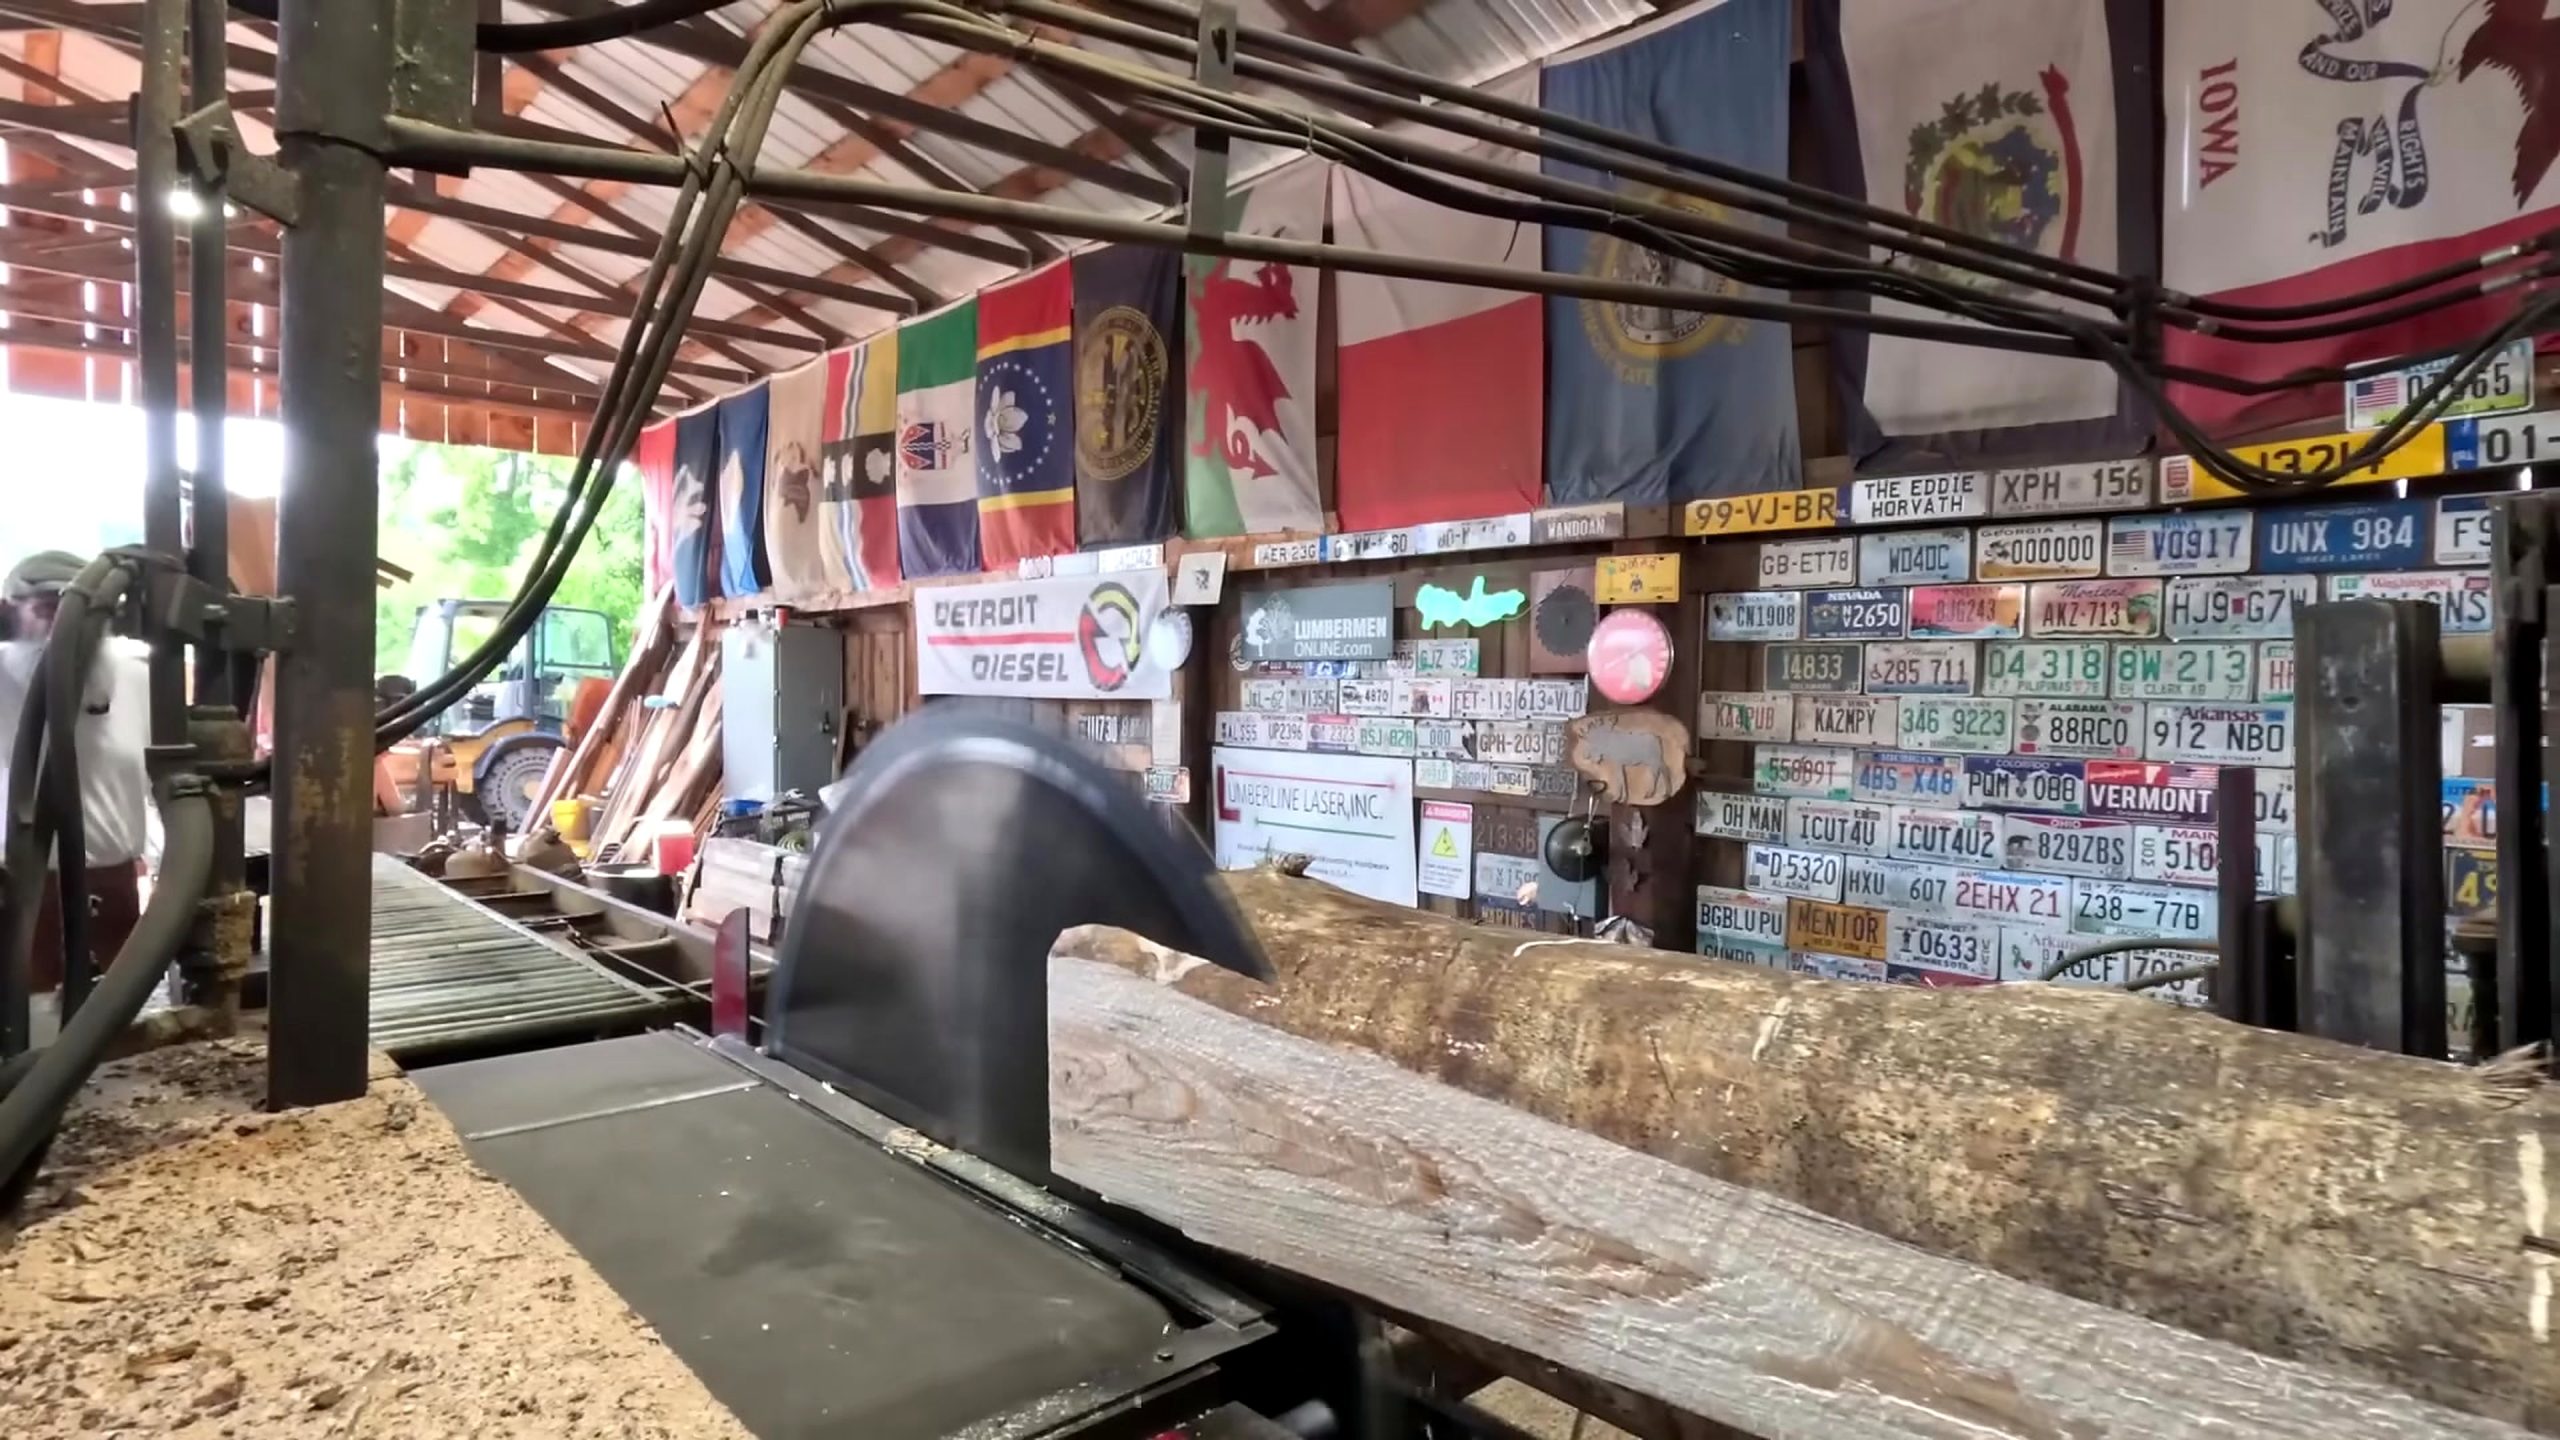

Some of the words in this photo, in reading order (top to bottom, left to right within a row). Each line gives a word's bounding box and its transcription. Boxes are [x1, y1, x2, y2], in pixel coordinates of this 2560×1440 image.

[2303, 51, 2341, 76] AND
[2346, 63, 2379, 79] OUR
[2200, 57, 2239, 189] IOWA
[2400, 119, 2425, 189] RIGHTS
[2329, 122, 2358, 232] MAINTAIN
[1864, 479, 1901, 500] THE
[1910, 475, 1974, 497] EDDIE
[2001, 471, 2061, 504] XPH
[2092, 466, 2144, 498] 156
[1694, 491, 1836, 530] 99-VJ-BR
[1871, 495, 1965, 518] HORVATH
[1546, 518, 1606, 538] WANDOAN
[1980, 526, 2055, 538] GEORGIA
[2270, 519, 2329, 555] UNX
[2351, 515, 2414, 551] 984
[1760, 549, 1849, 577] GB-ET78
[1826, 590, 1882, 601] NEVADA
[934, 594, 1039, 628] DETROIT
[1852, 602, 1901, 629] 2650
[1294, 616, 1387, 641] LUMBERMEN
[1293, 641, 1374, 658] ONLINE.com
[971, 653, 1069, 682] DIESEL
[1781, 653, 1843, 681] 14833
[1883, 658, 1920, 685] 285
[1930, 658, 1966, 685] 711
[2040, 649, 2100, 680] 318
[2117, 649, 2162, 682] 8W
[2176, 649, 2246, 683] 213
[1517, 688, 1547, 711] 613
[2048, 703, 2108, 714] ALABAMA
[1902, 707, 1941, 735] 346
[1952, 707, 2006, 737] 9223
[2178, 705, 2261, 724] Arkansas
[1479, 734, 1542, 755] GPH-203
[2152, 719, 2207, 750] 912
[1995, 759, 2051, 770] COLORADO
[1968, 770, 2010, 798] PQM
[2089, 783, 2213, 815] VERMONT
[1722, 802, 1744, 828] OH
[1749, 808, 1783, 833] MAN
[1800, 813, 1876, 847] ICUT4U
[2049, 818, 2082, 830] OHIO
[1897, 822, 1995, 858] ICUT4U2
[2170, 829, 2218, 842] MAIN
[1771, 879, 1811, 892] ALASKA
[1849, 869, 1886, 896] HXU
[1909, 877, 1948, 903] 607
[1954, 880, 2021, 914] 2EHX
[2029, 887, 2062, 919] 21
[1796, 902, 1879, 945] MENTOR
[1919, 929, 1978, 963] 0633
[1912, 955, 1970, 972] MINNESOTA
